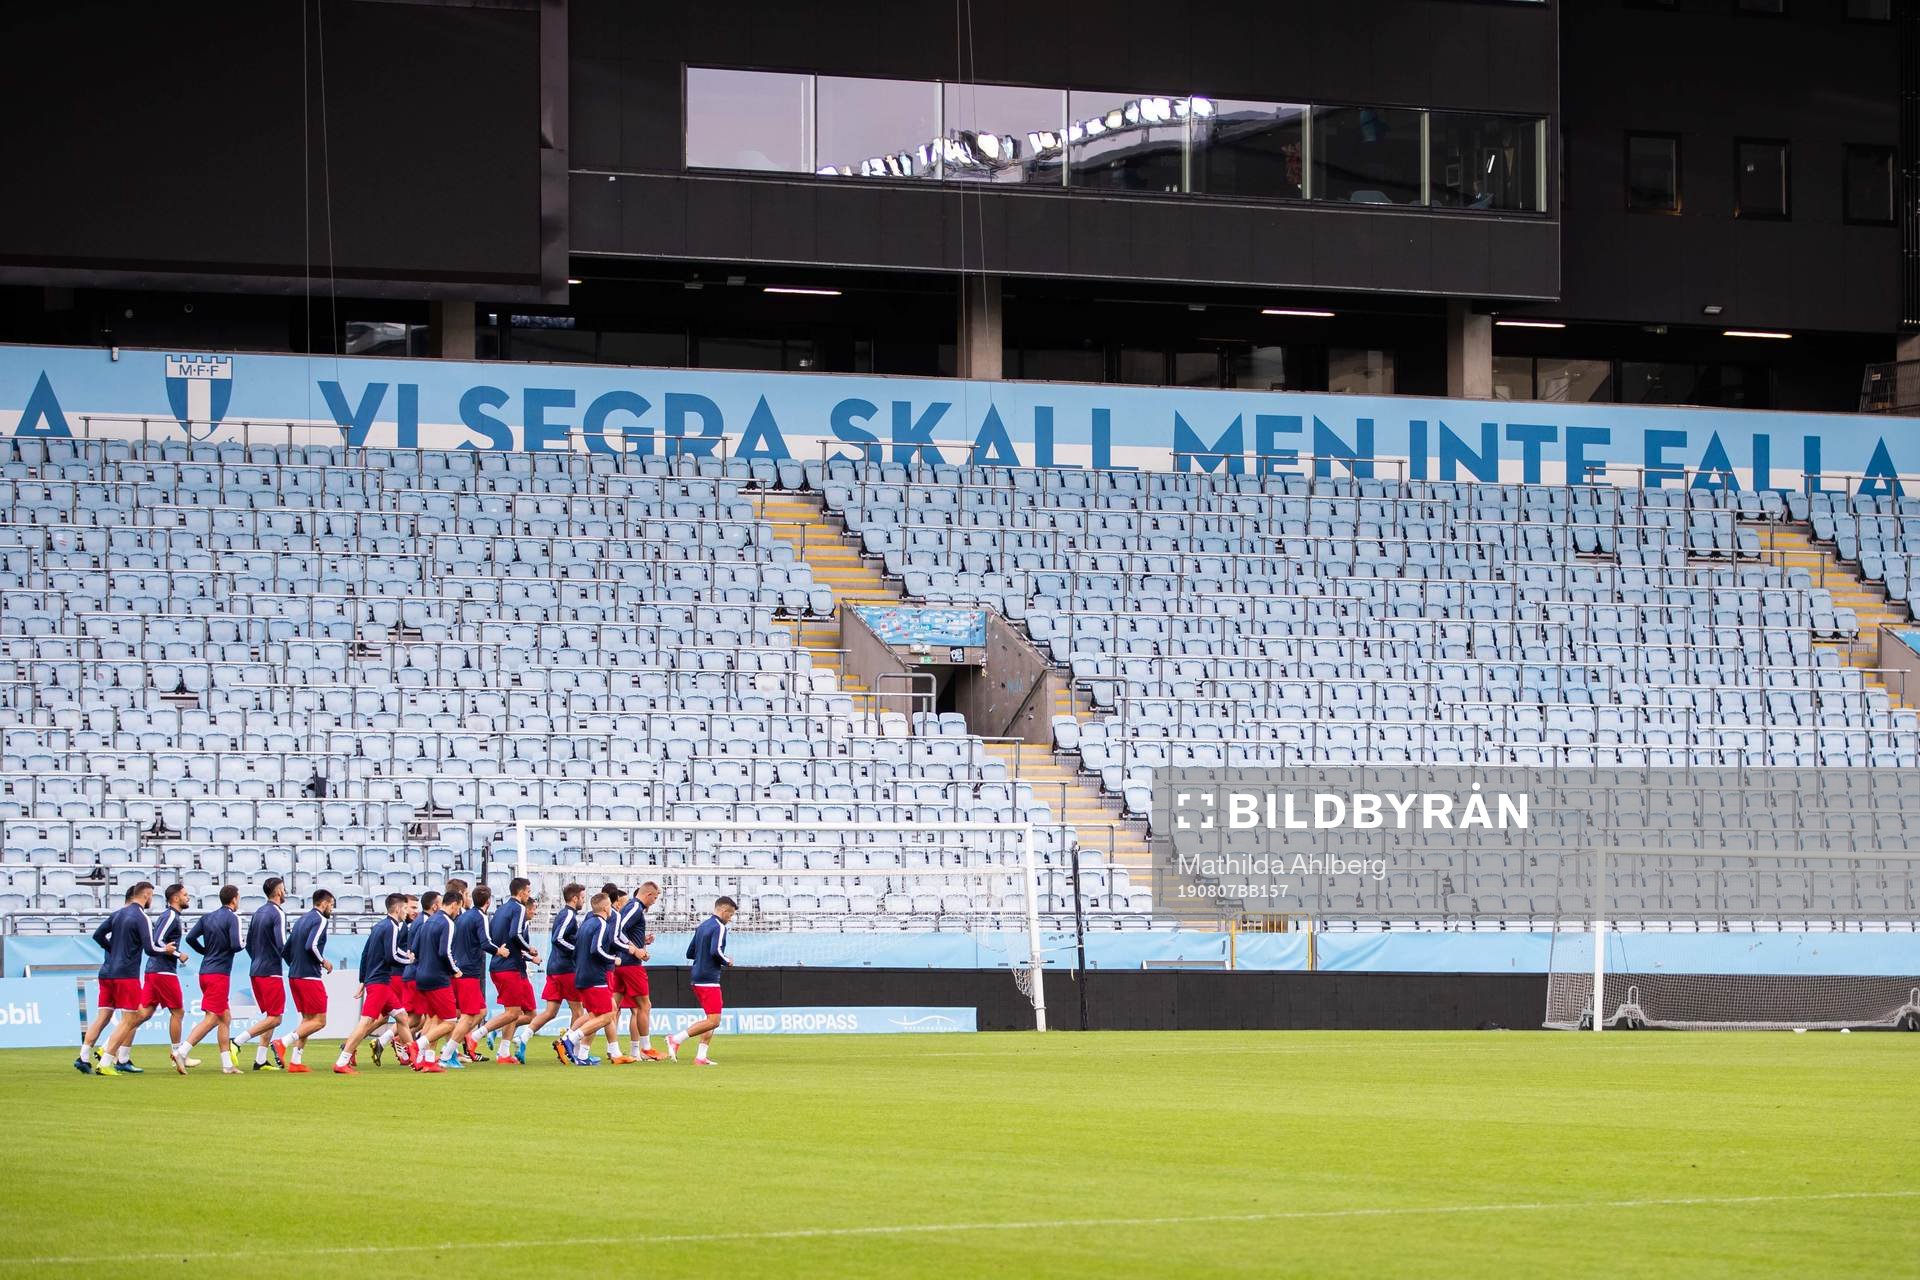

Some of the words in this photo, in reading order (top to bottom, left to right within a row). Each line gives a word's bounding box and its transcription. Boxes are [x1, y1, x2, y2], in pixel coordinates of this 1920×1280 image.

[317, 380, 419, 448] VI
[456, 385, 792, 460] SEGRA
[828, 398, 1139, 470] SKALL
[1174, 410, 1374, 480] MEN
[1409, 419, 1612, 487] INTE
[1644, 429, 1906, 496] FALLA
[739, 1014, 776, 1030] MED
[780, 1014, 858, 1030] BROPASS
